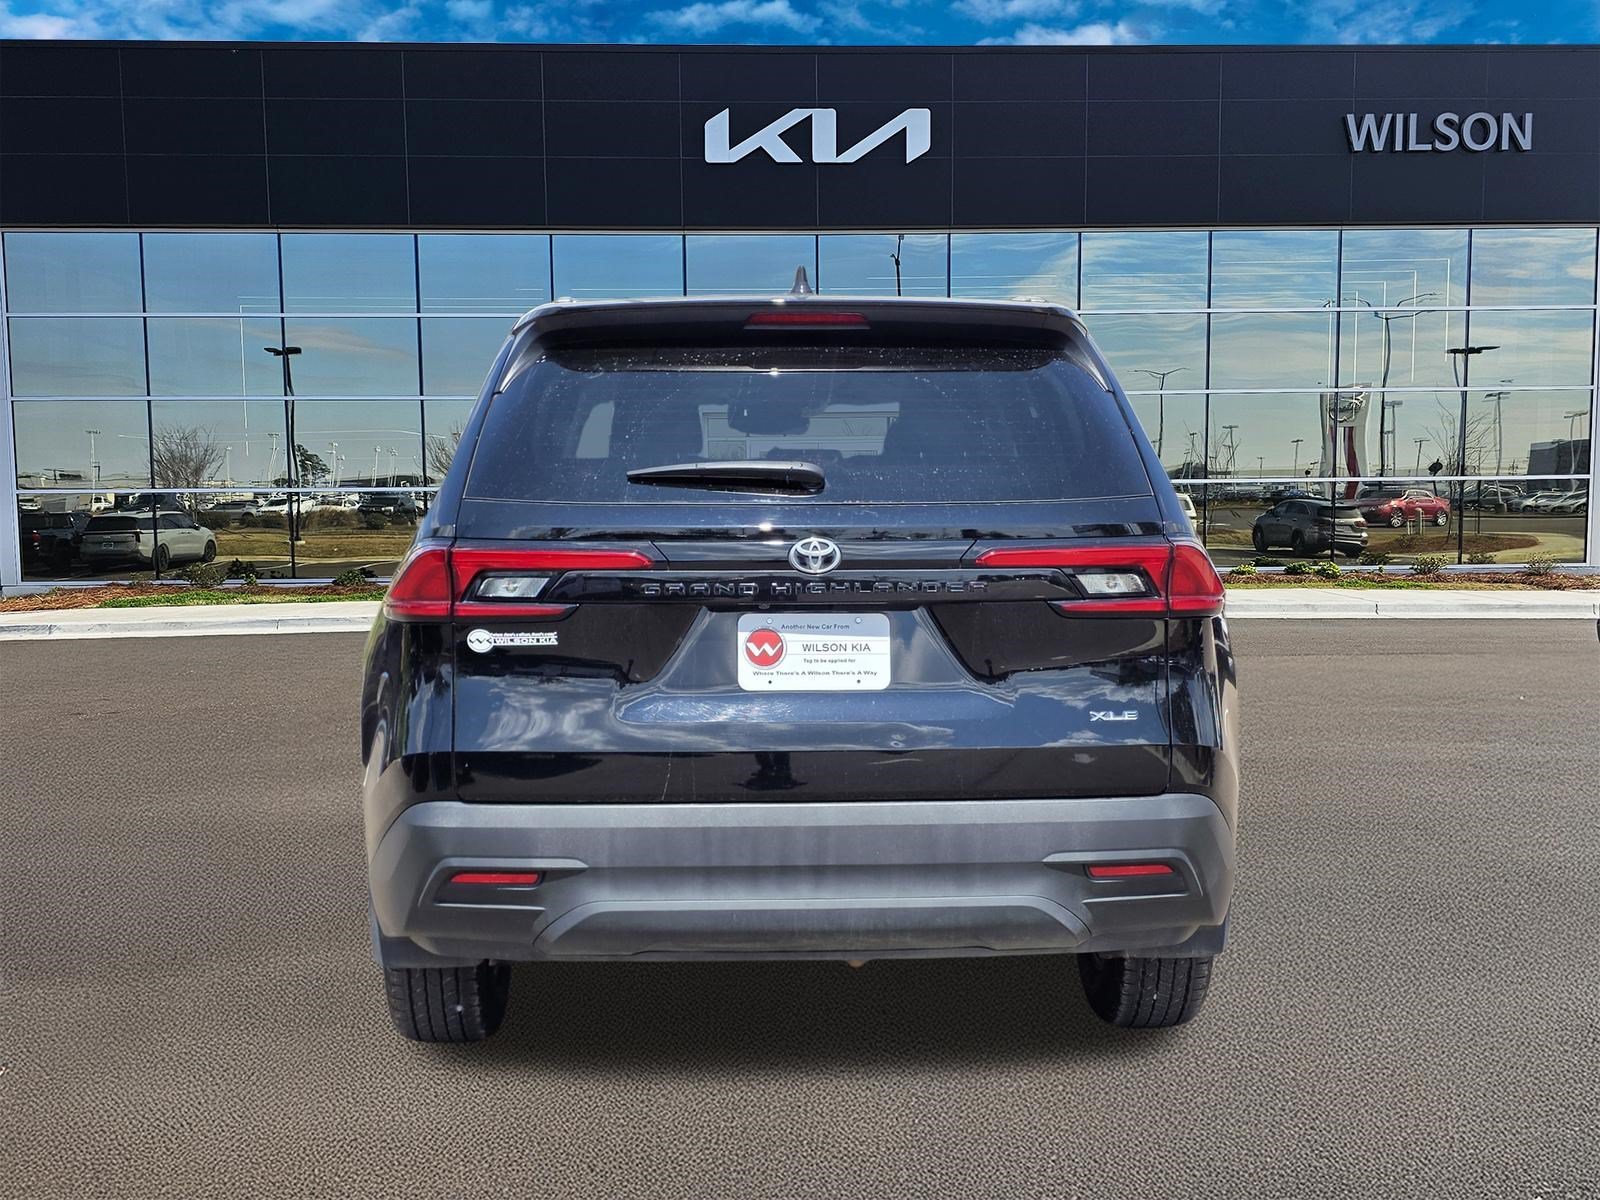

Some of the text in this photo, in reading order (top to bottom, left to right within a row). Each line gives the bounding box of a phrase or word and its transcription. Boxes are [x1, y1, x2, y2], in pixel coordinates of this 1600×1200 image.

[1345, 112, 1533, 151] WILSON
[640, 581, 990, 596] GRAND HIGHLANDER
[802, 643, 871, 652] WILSON KIA
[1089, 710, 1138, 721] XLE
